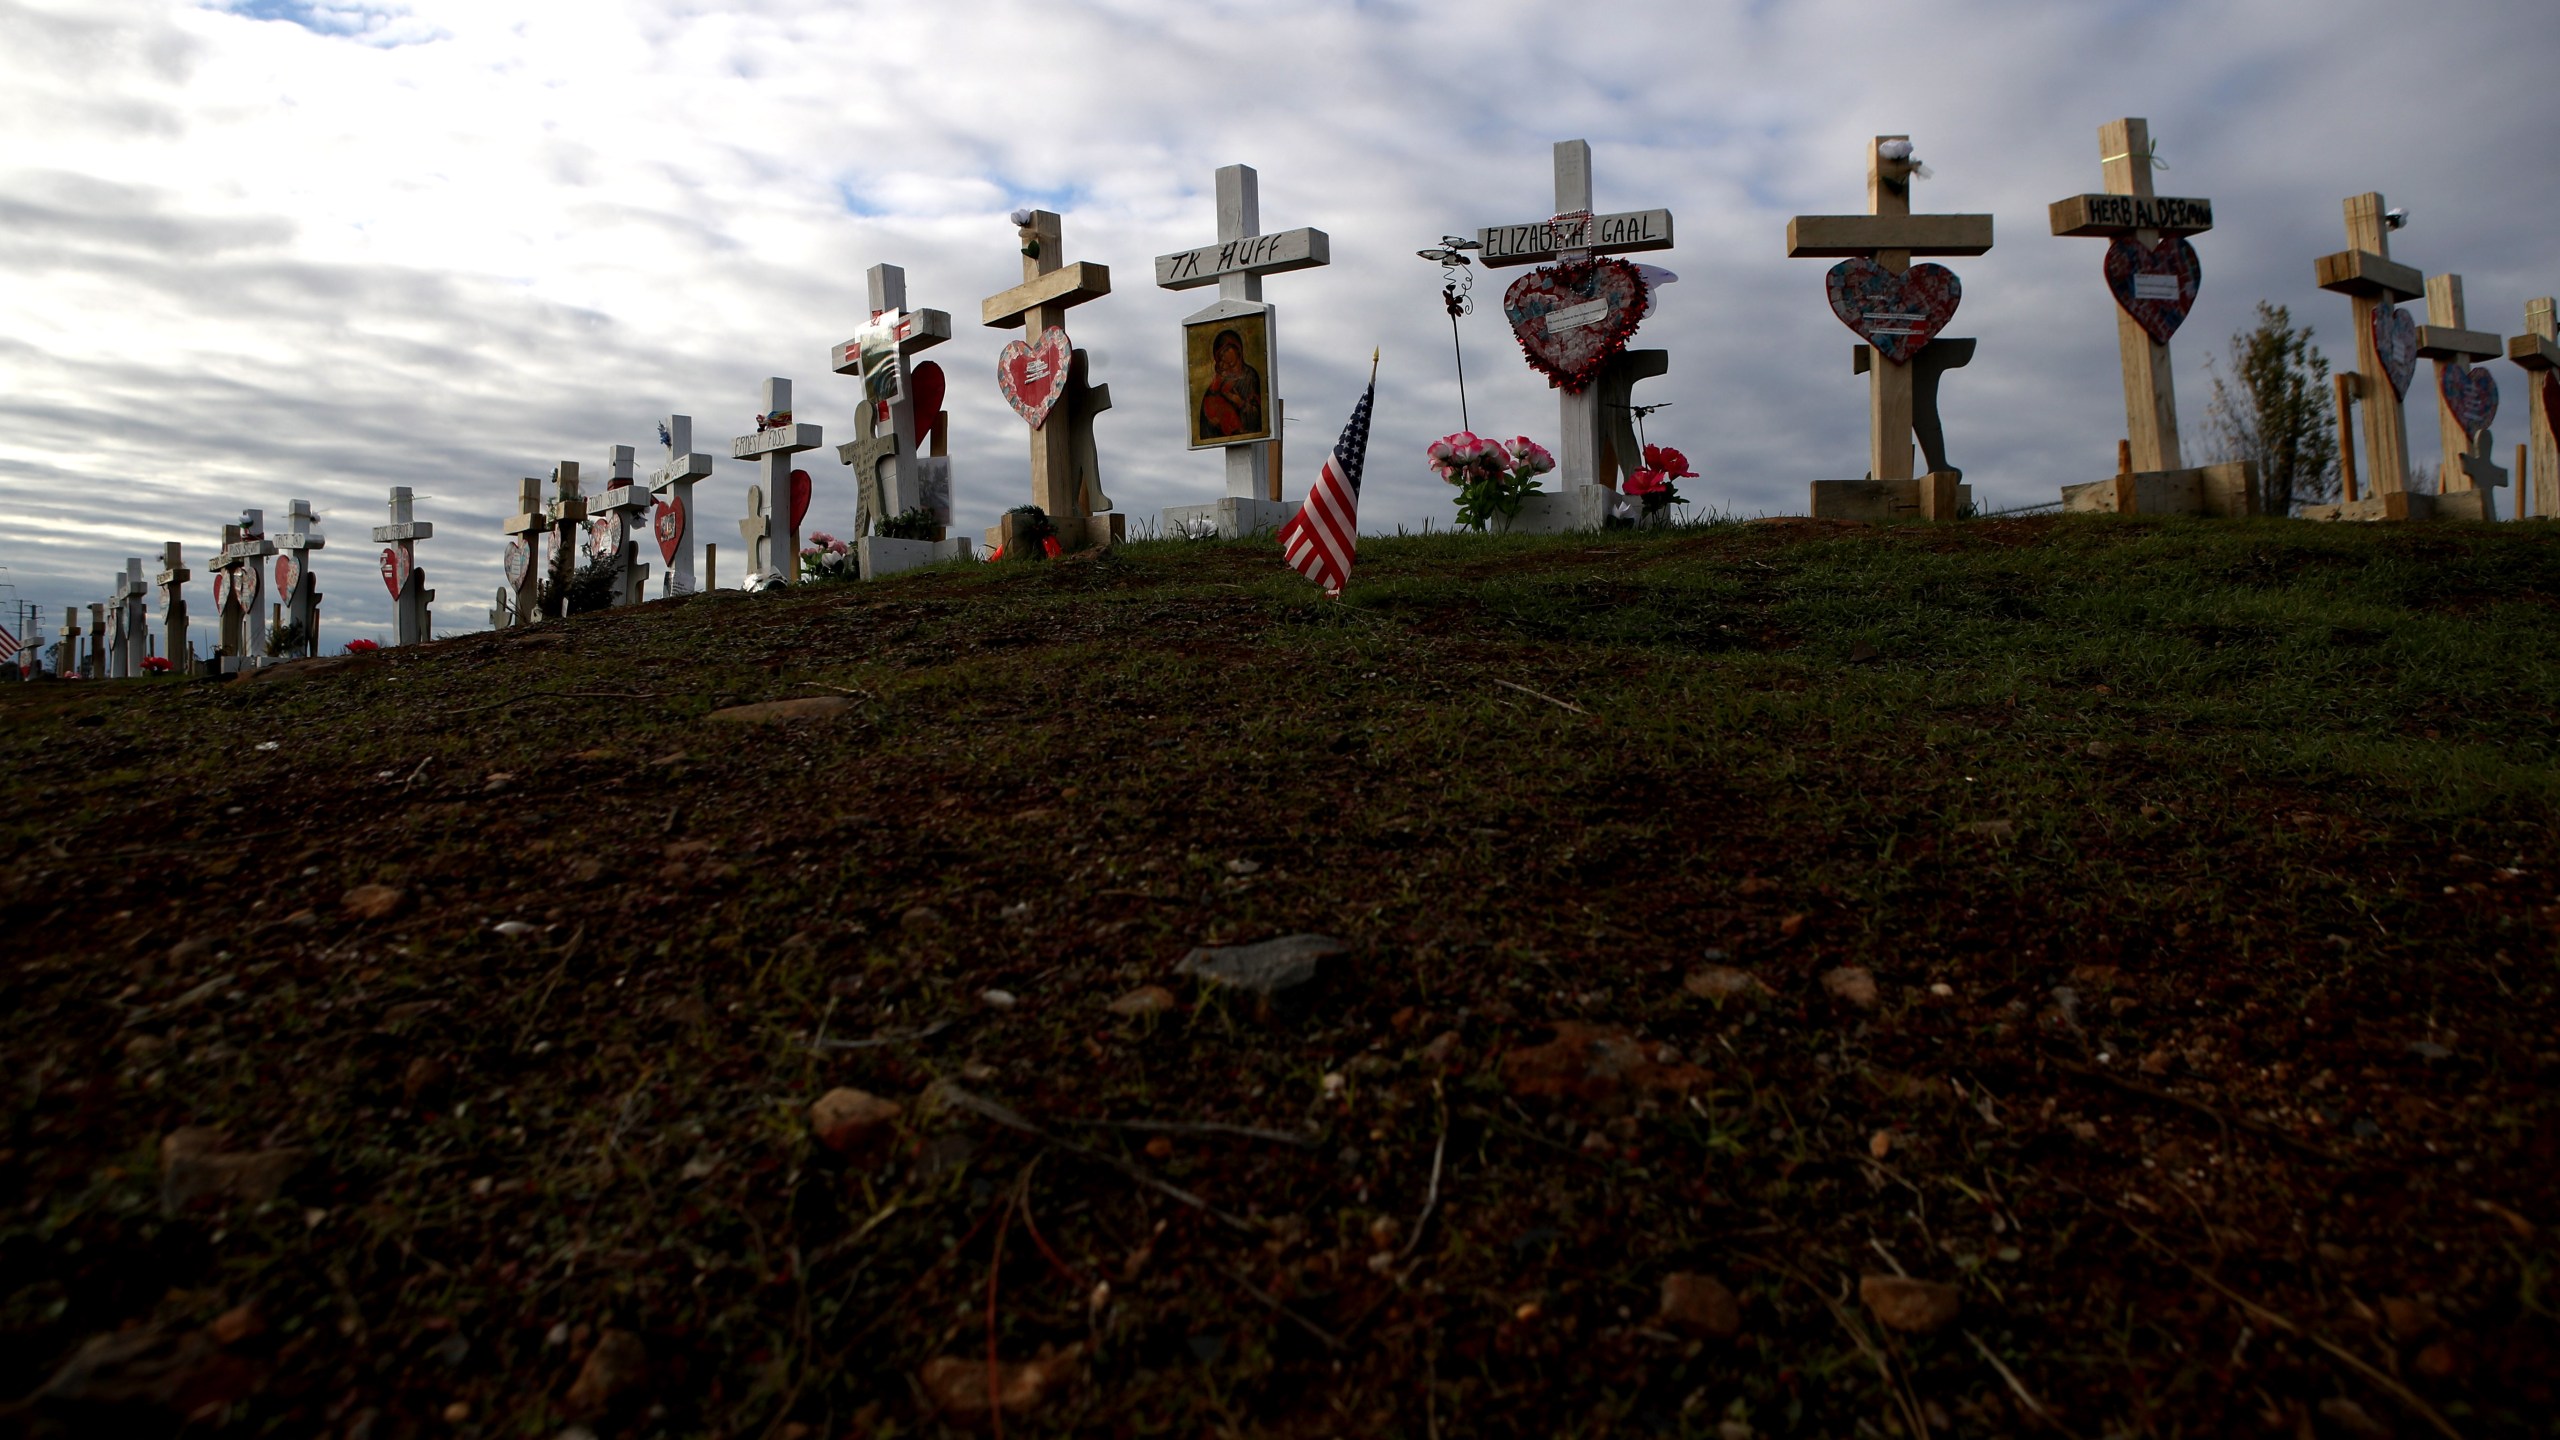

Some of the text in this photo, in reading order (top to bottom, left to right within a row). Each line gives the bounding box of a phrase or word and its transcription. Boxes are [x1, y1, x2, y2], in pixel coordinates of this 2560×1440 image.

[2089, 196, 2132, 226] HERB
[1486, 215, 1656, 256] ELIZABETH GAAL
[1170, 234, 1281, 279] TK HUFF
[768, 428, 787, 448] FOSS
